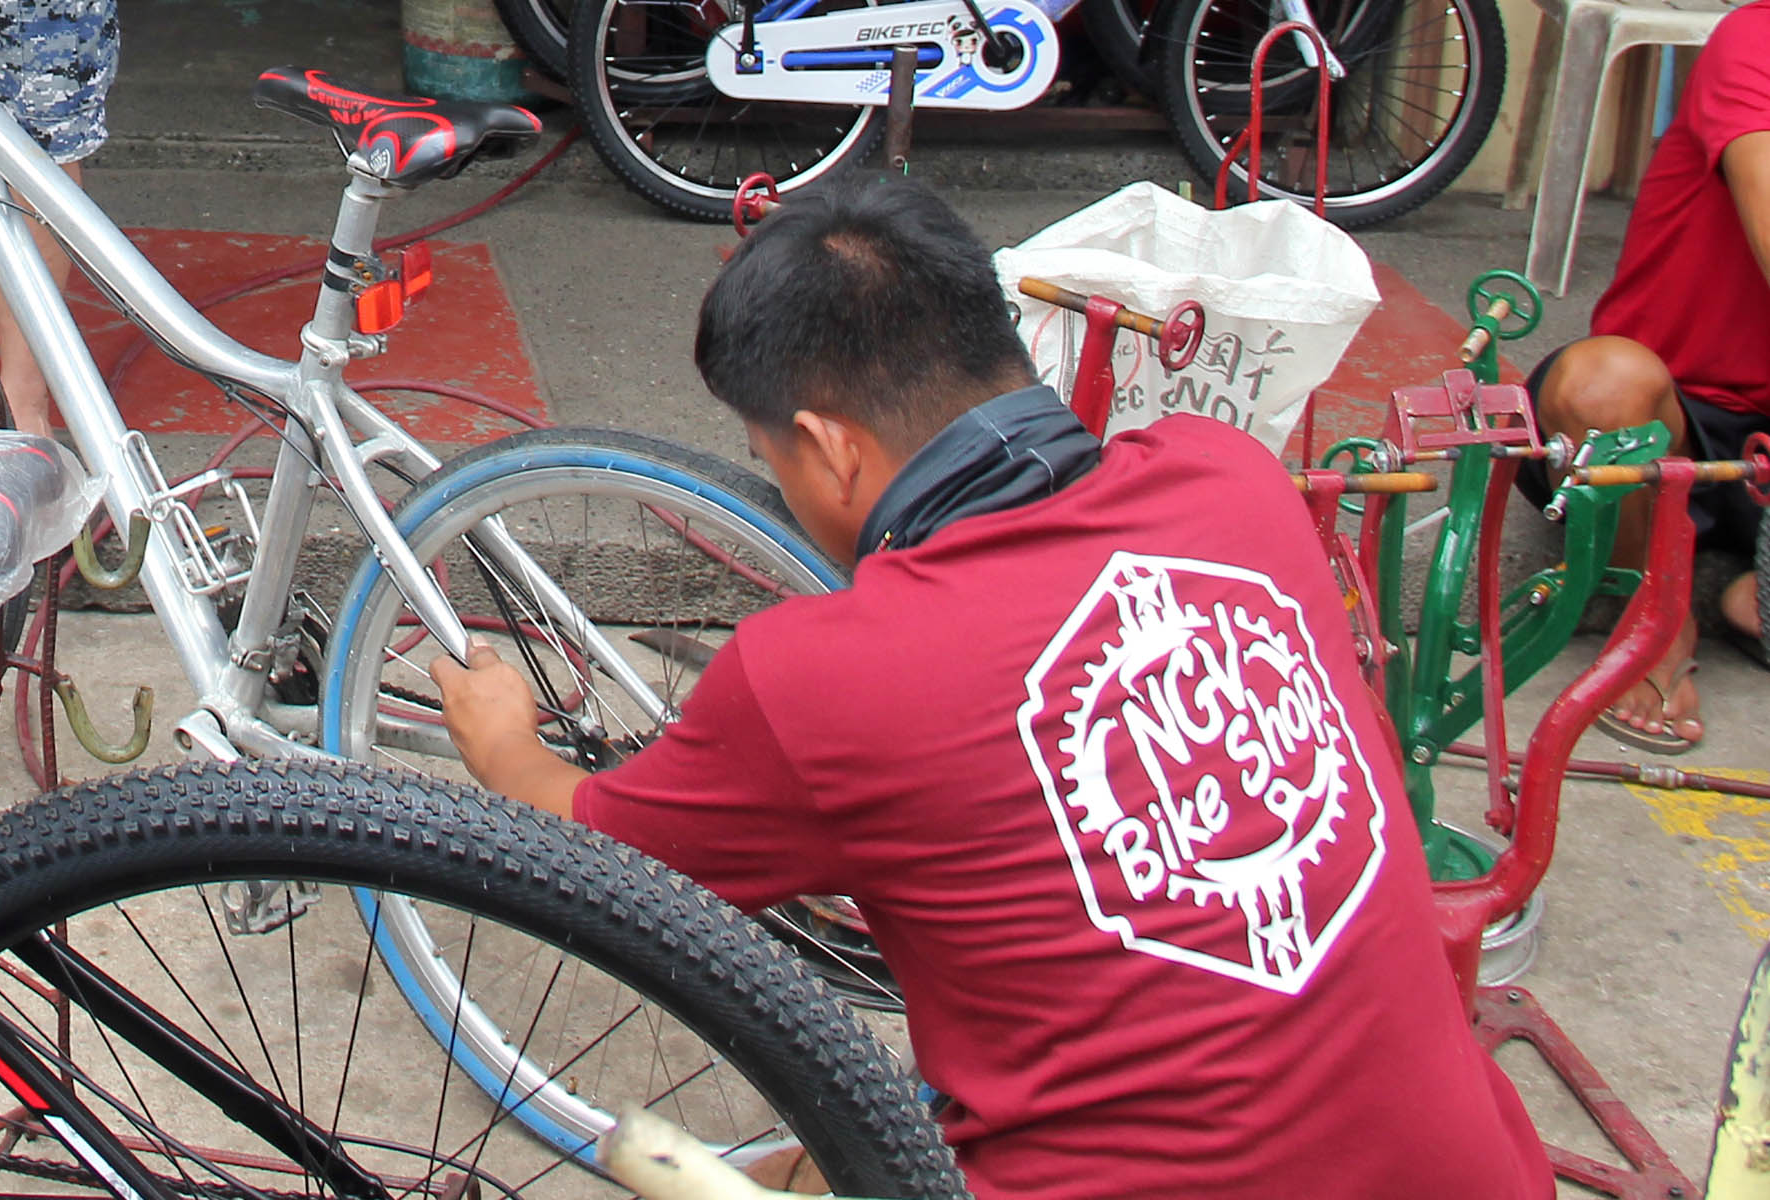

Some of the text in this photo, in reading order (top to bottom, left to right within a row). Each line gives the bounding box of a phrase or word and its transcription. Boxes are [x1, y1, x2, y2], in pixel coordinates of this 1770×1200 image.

[856, 21, 947, 43] BIKETEC
[308, 85, 367, 110] Century
[329, 107, 387, 126] New
[1103, 774, 1230, 901] Bike
